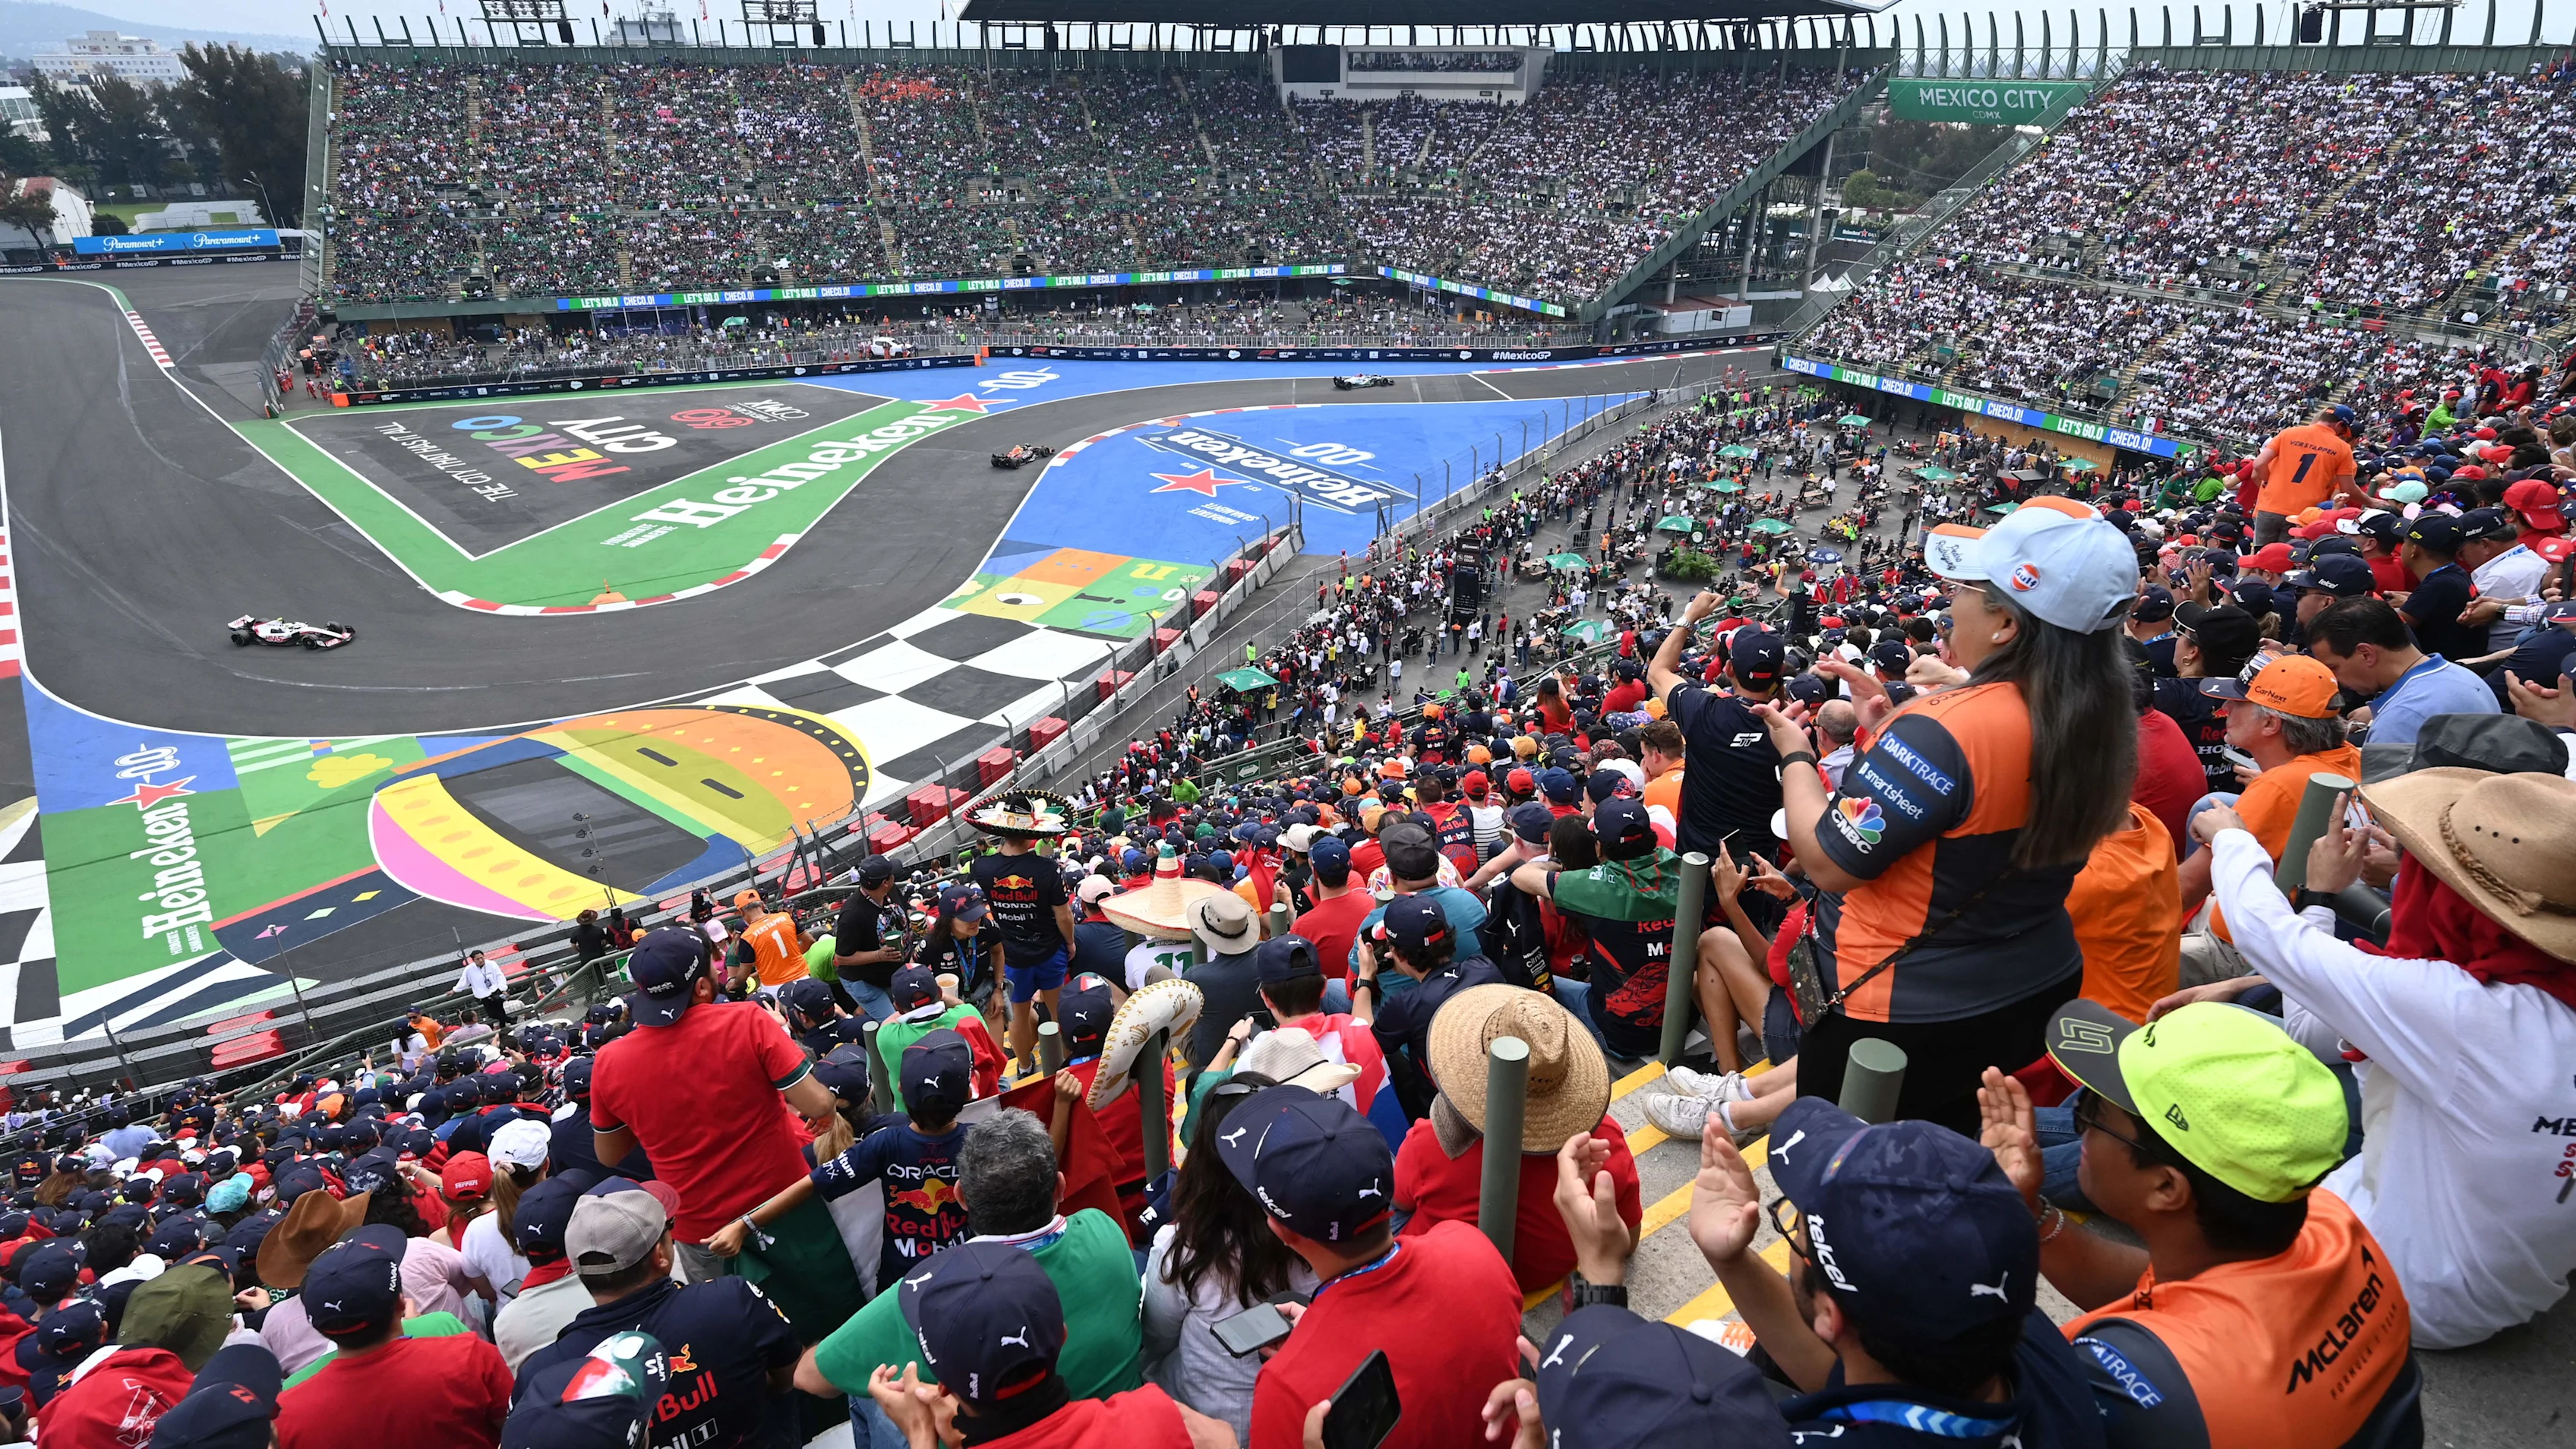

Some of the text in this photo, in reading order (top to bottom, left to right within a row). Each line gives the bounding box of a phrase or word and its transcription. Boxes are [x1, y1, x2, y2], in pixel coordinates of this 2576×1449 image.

[1919, 87, 2053, 109] MEXICO CITY
[1972, 110, 2001, 119] CDMX
[103, 237, 165, 251] Paramount+
[1140, 273, 1155, 282] LET'S
[1221, 269, 1236, 278] LET'S
[1300, 265, 1315, 275] LET'S
[968, 280, 983, 290] LET'S
[1056, 276, 1072, 286] LET'S
[684, 293, 702, 303] LET'S
[781, 289, 801, 298] LET'S
[877, 285, 895, 295] LET'S
[581, 298, 599, 308] LET'S
[1492, 351, 1552, 360] #MexicoGP
[1842, 370, 1861, 385] LET'S
[1942, 391, 1963, 408] LET'S
[547, 416, 677, 453] CITY
[2057, 418, 2082, 434] LET'S
[451, 415, 631, 483] MEXICO
[2058, 446, 2111, 465] JOHNNIE WALKER
[2290, 440, 2338, 456] VERSTAPPEN
[374, 421, 519, 502] THE CITY THAT HAS IT ALL
[1166, 431, 1390, 507] Heineken
[2291, 453, 2318, 484] 1
[630, 414, 958, 529] Heineken
[2465, 526, 2483, 537] telcel
[2015, 567, 2038, 587] Gulf
[2318, 579, 2339, 589] telcel
[2255, 686, 2287, 703] CarNext
[1883, 737, 1955, 796] DARKTRACE
[1864, 769, 1924, 820] smartsheet
[1452, 817, 1469, 829] Bull
[1830, 808, 1873, 854] CNBC
[1443, 832, 1466, 844] Mobil
[130, 802, 213, 939] Heineken
[990, 889, 1039, 901] Red Bull
[993, 901, 1037, 909] HONDA
[998, 912, 1026, 921] Mobil
[771, 929, 788, 959] 1
[684, 955, 699, 981] telcel
[1154, 951, 1192, 980] 11
[1526, 951, 1544, 968] Citrix
[819, 1019, 837, 1031] HONDA
[454, 1179, 478, 1189] Ferrari
[1257, 1185, 1293, 1219] telcel
[886, 1211, 938, 1237] Red
[1807, 1213, 1860, 1293] telcel
[2285, 1272, 2385, 1395] McLaren
[2331, 1346, 2374, 1401] FORMULA
[657, 1369, 719, 1422] Bull
